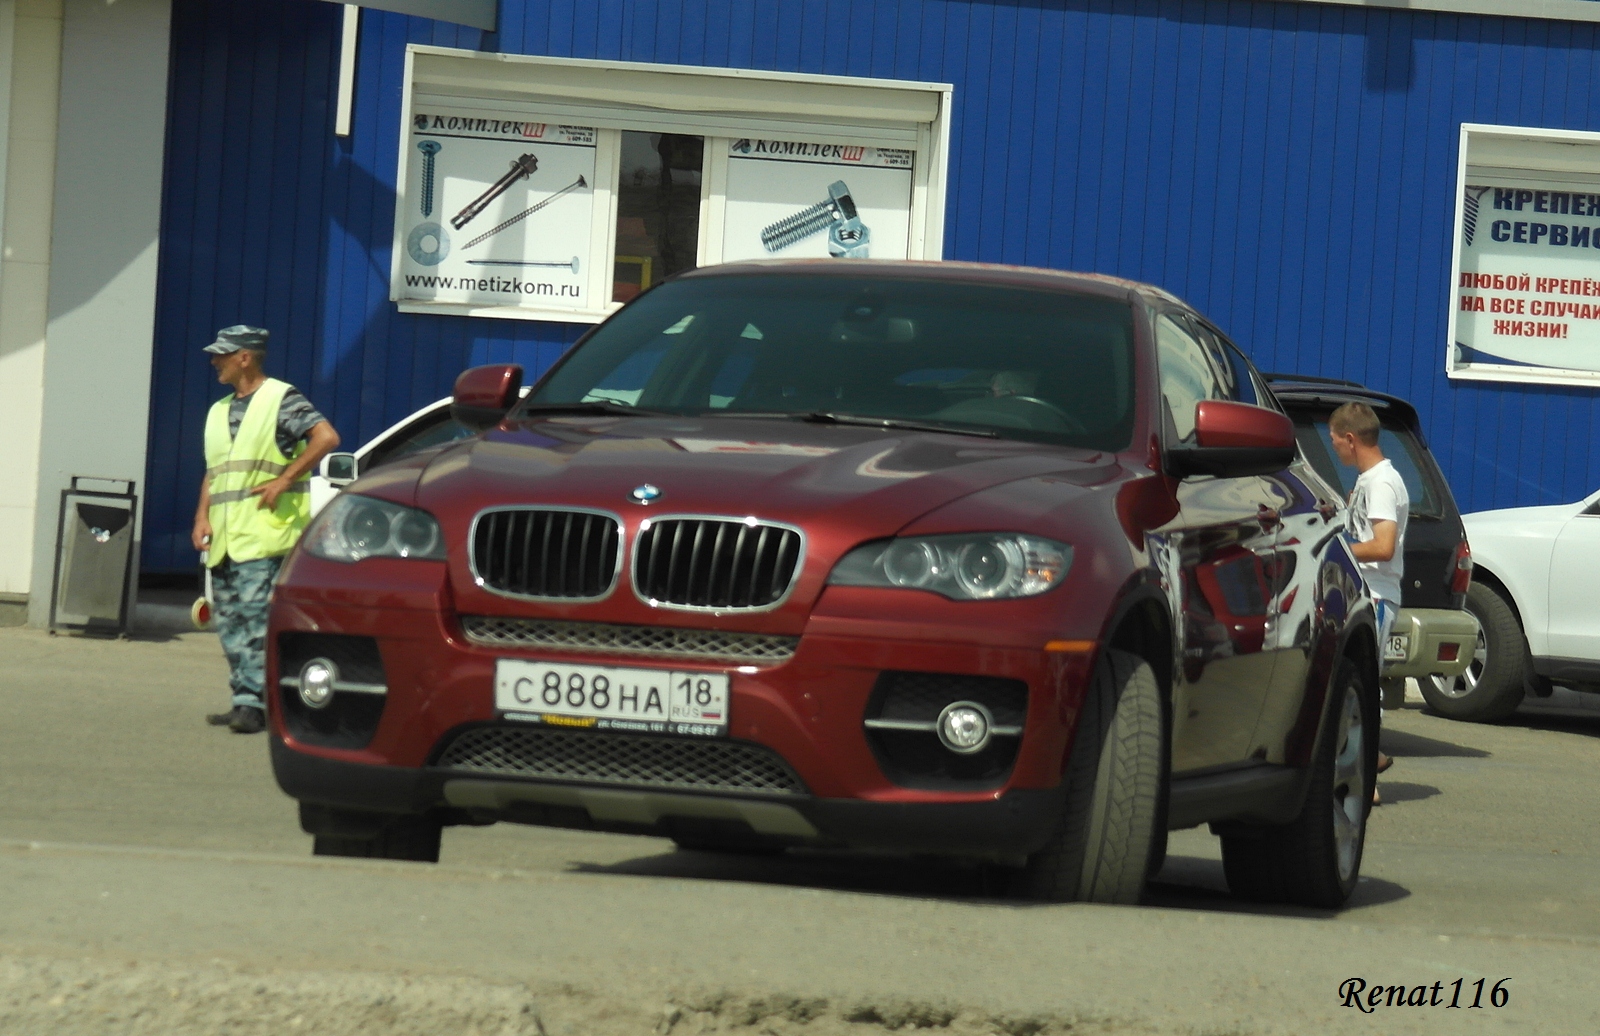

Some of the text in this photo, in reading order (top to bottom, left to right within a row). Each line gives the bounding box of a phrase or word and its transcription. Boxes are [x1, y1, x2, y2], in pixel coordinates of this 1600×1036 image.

[405, 274, 580, 297] www.metizkom.ru
[1459, 271, 1530, 292] ЛЮБОЙ
[1460, 295, 1485, 312] НА
[1490, 297, 1525, 315] ВСЕ
[1493, 319, 1568, 339] ЖИЗНИ!
[678, 677, 712, 706] 18
[672, 706, 700, 718] RUS
